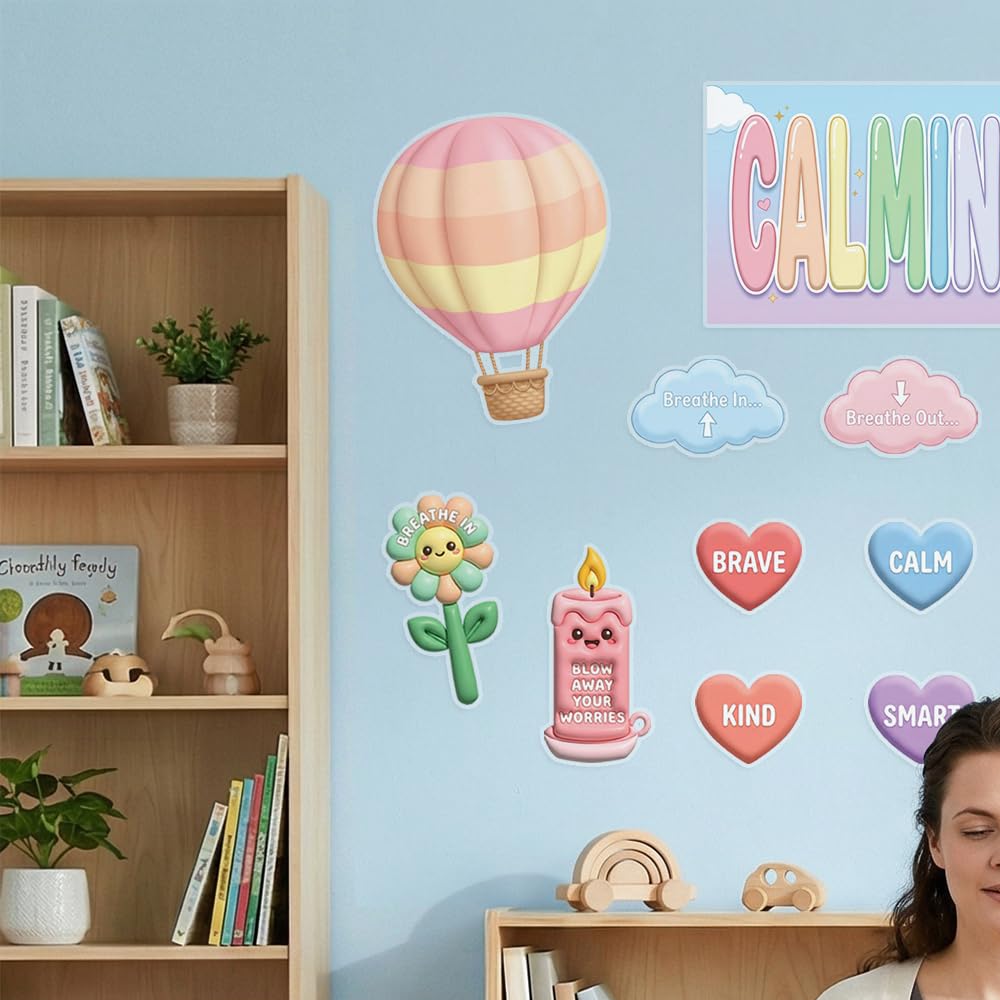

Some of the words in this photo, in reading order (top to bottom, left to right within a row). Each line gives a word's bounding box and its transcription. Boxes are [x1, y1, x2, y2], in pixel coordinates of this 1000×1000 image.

[663, 391, 728, 408] Breathe
[733, 391, 762, 408] In...
[846, 409, 911, 427] Breathe
[916, 409, 959, 427] Out...
[396, 508, 460, 546] BREATHE
[460, 518, 477, 535] IN
[712, 550, 786, 574] BRAVE
[889, 550, 952, 574] CALM
[571, 663, 613, 676] BLOW
[571, 679, 613, 692] AWAY
[573, 695, 612, 708] YOUR
[559, 711, 625, 724] WORRIES
[722, 703, 776, 727] KIND
[883, 704, 962, 728] SMART
